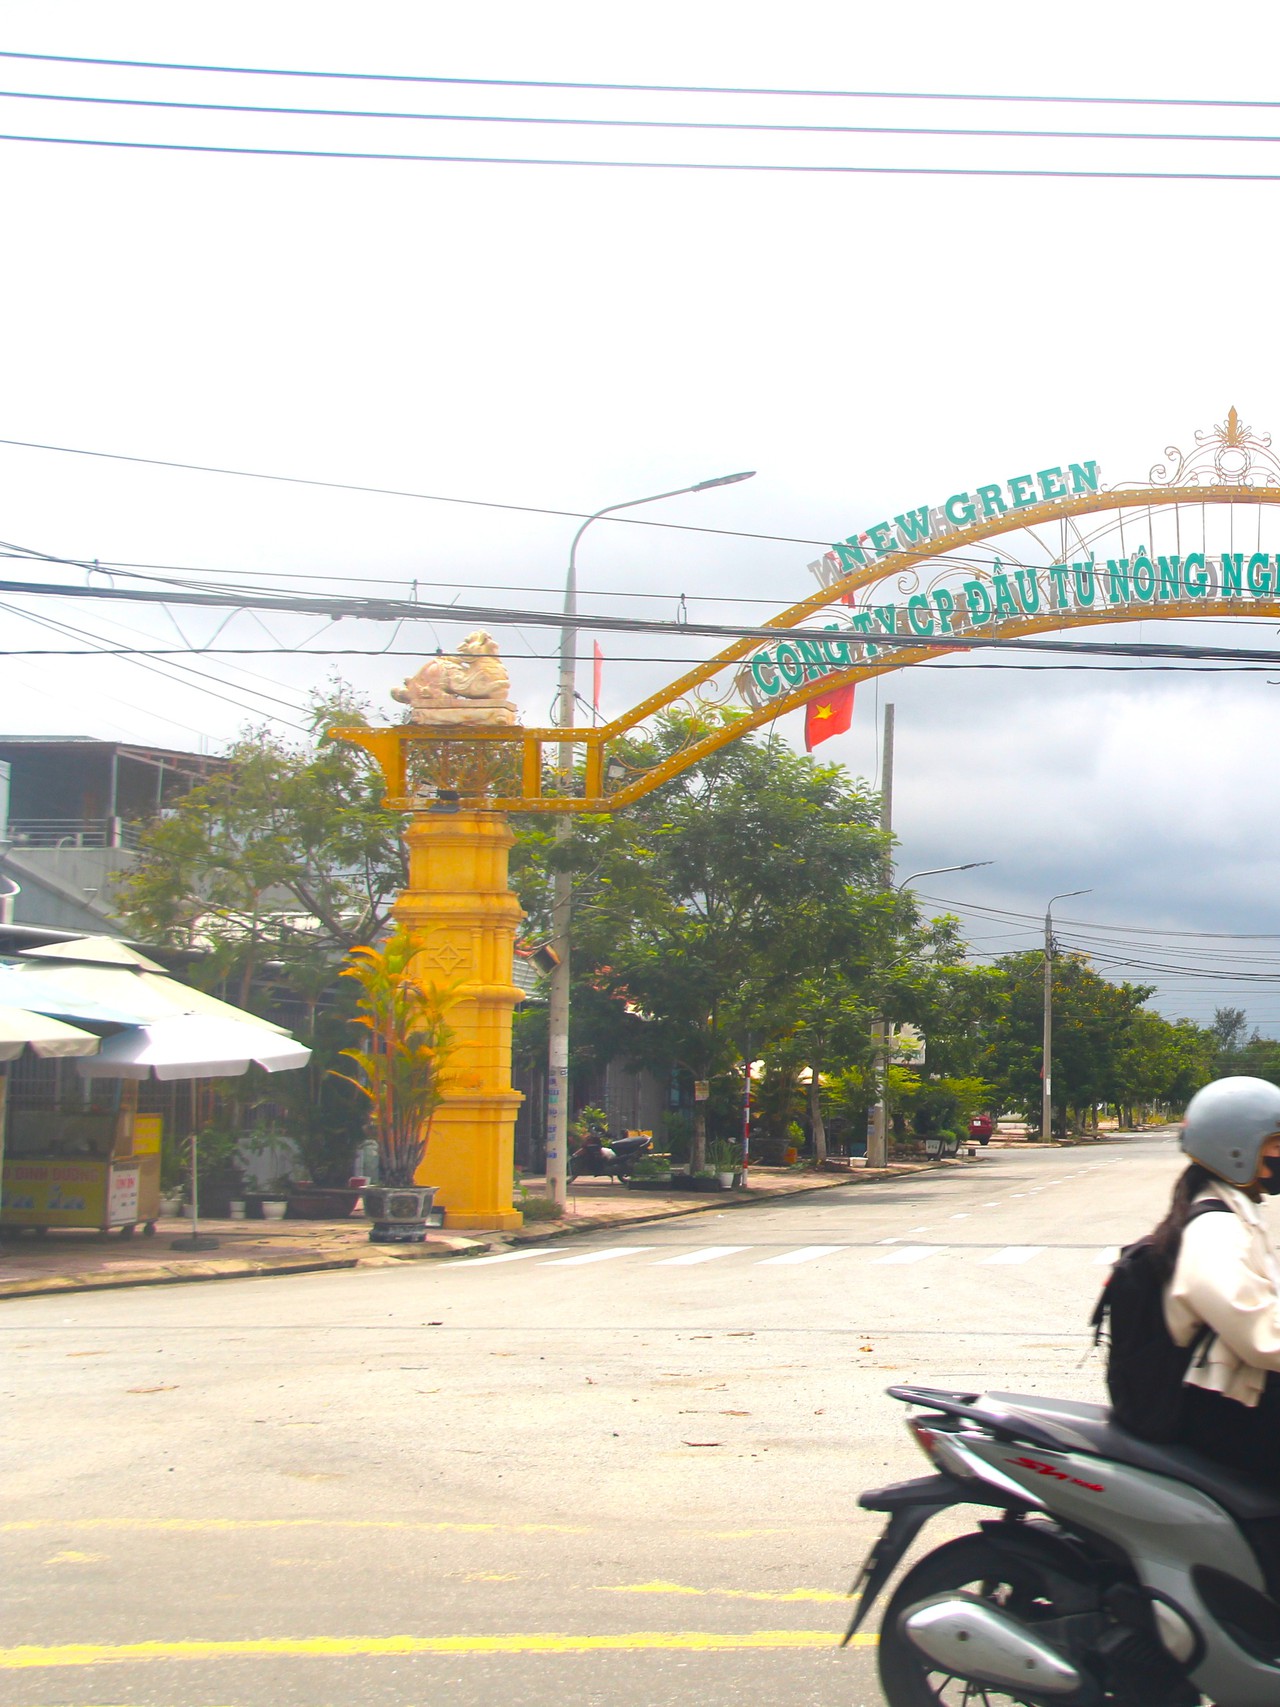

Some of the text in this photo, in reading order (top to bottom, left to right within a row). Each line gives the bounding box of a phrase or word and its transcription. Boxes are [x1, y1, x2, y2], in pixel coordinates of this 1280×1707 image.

[831, 505, 932, 574] NEW
[945, 460, 1099, 527] GREEN
[907, 588, 955, 637] CP
[1106, 545, 1209, 604] NÔNG
